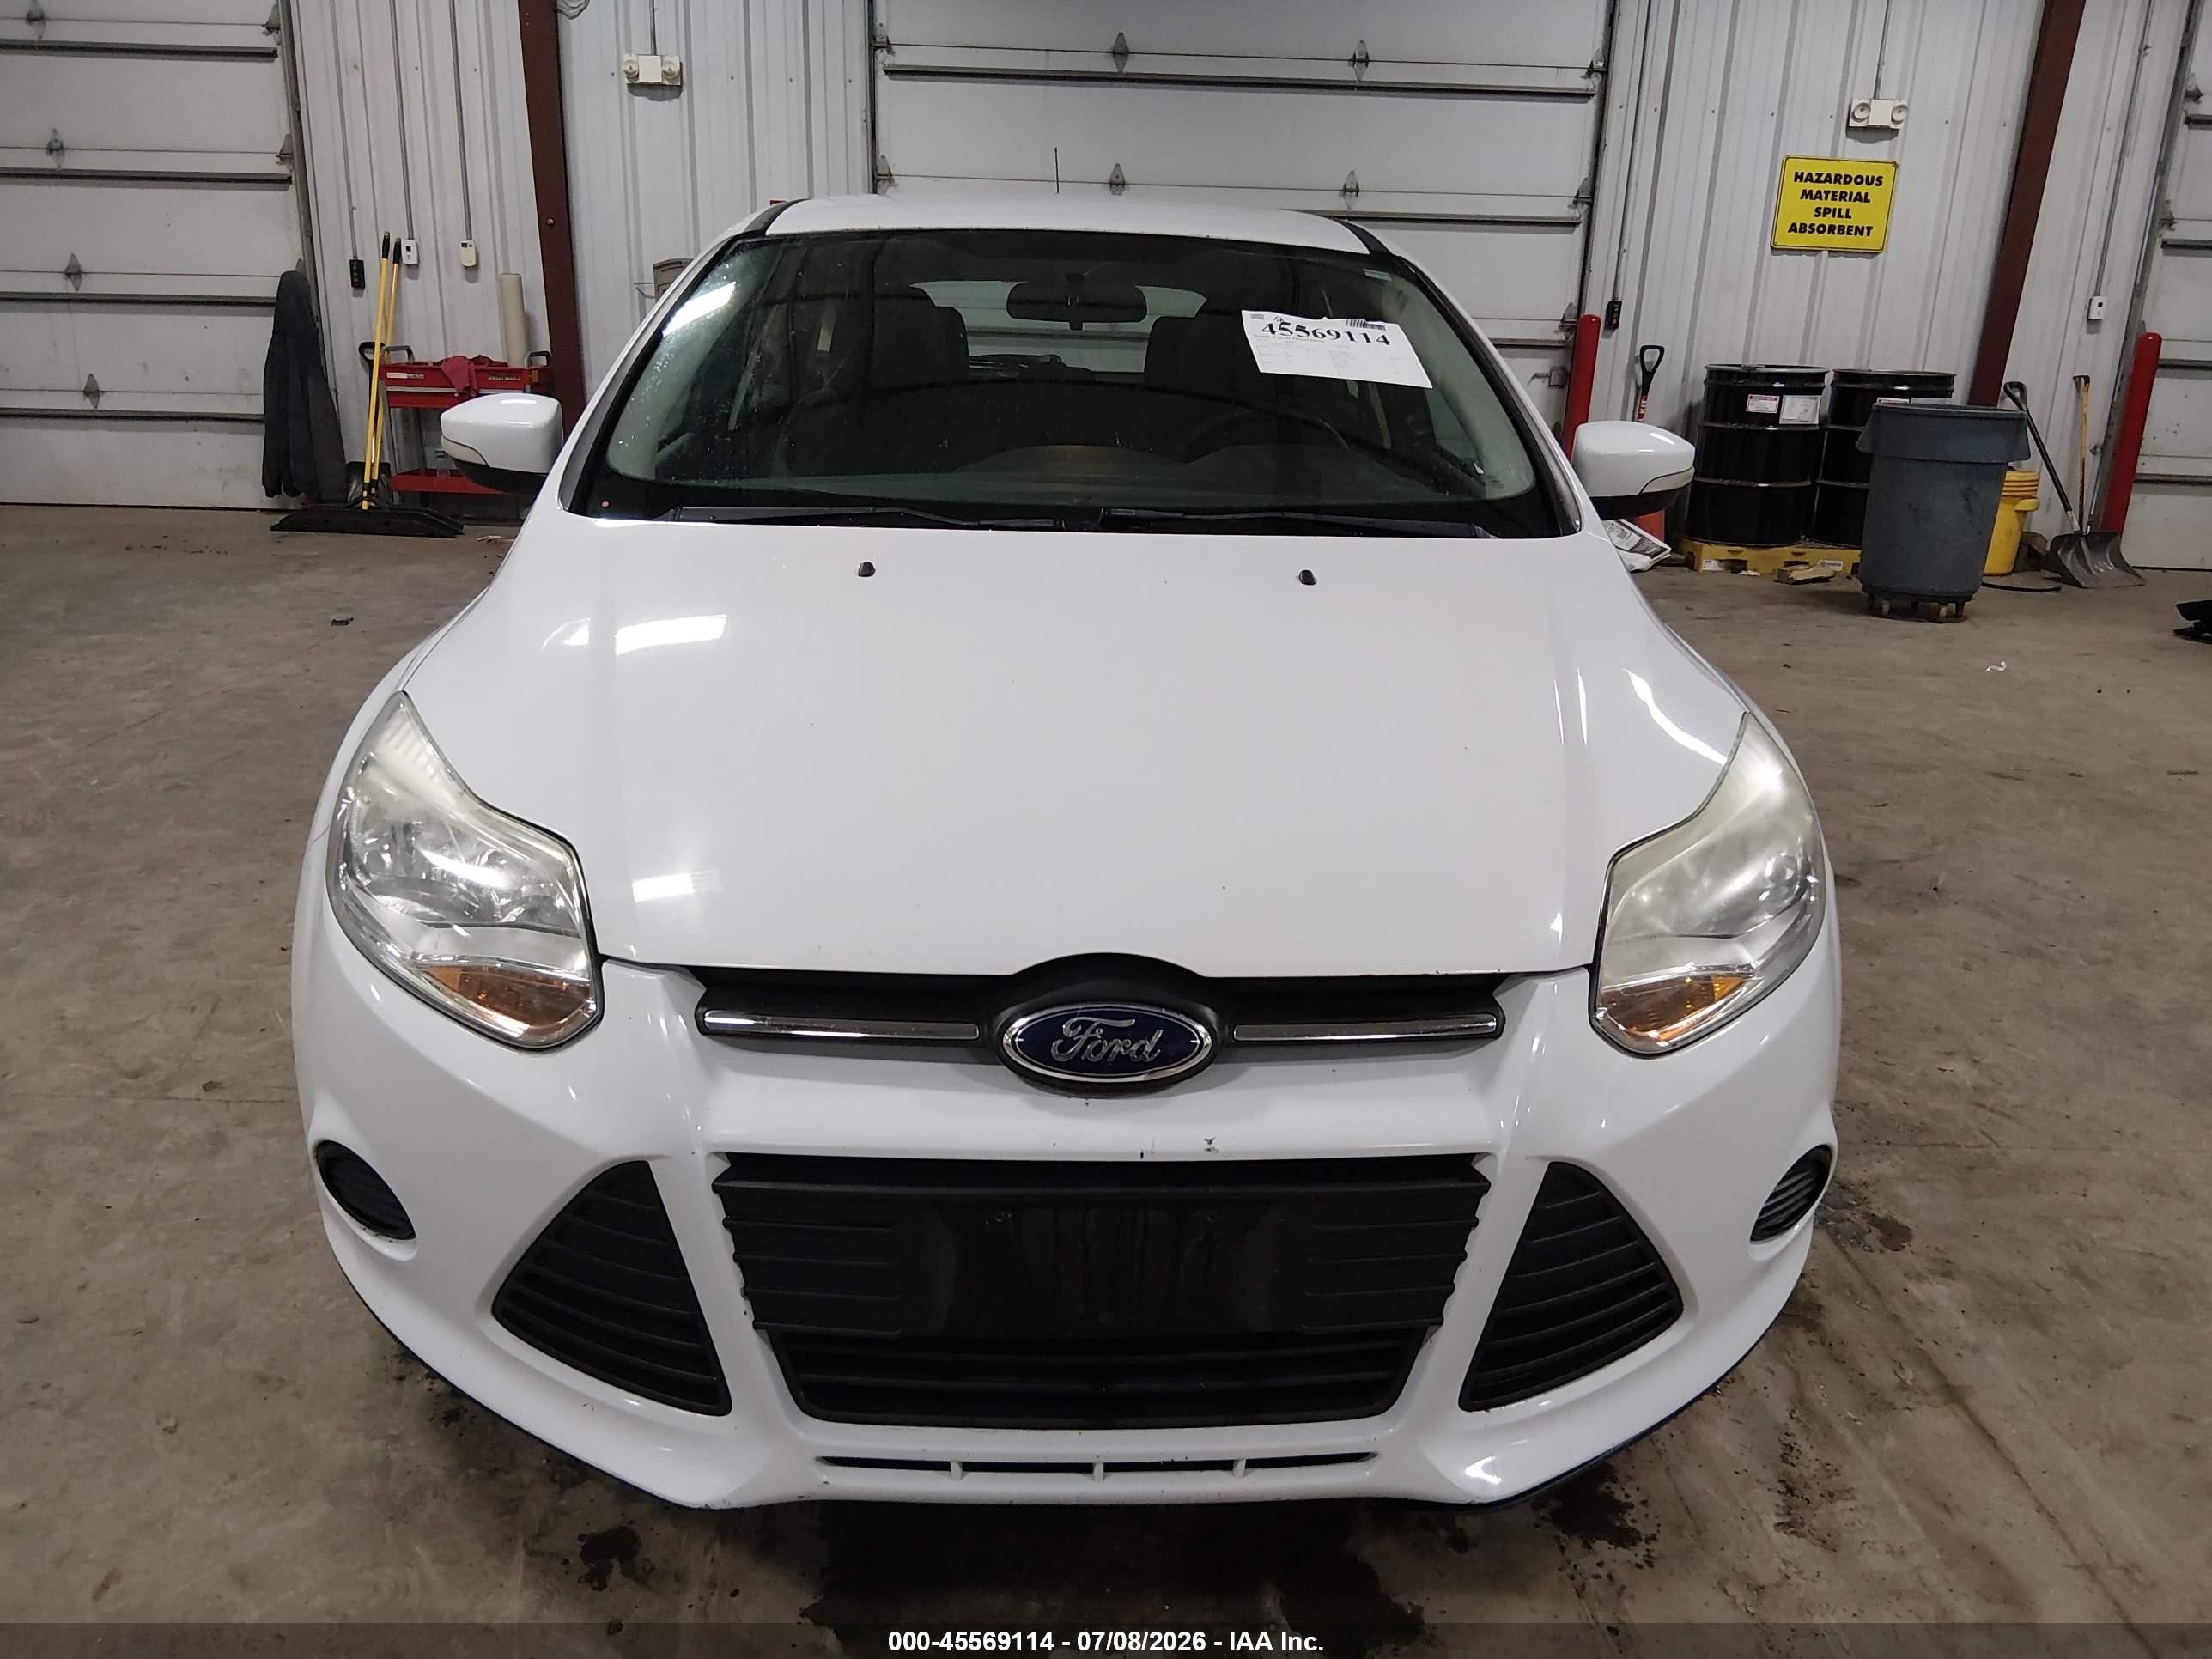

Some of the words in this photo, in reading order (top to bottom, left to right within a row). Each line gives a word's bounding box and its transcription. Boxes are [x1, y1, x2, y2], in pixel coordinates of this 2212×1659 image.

[1793, 171, 1884, 187] HAZARDOUS
[1800, 189, 1871, 204] MATERIAL
[1814, 206, 1852, 220] SPILL
[1787, 222, 1874, 237] ABSORBENT
[1261, 321, 1391, 346] 45569114
[1050, 1016, 1164, 1063] Ford
